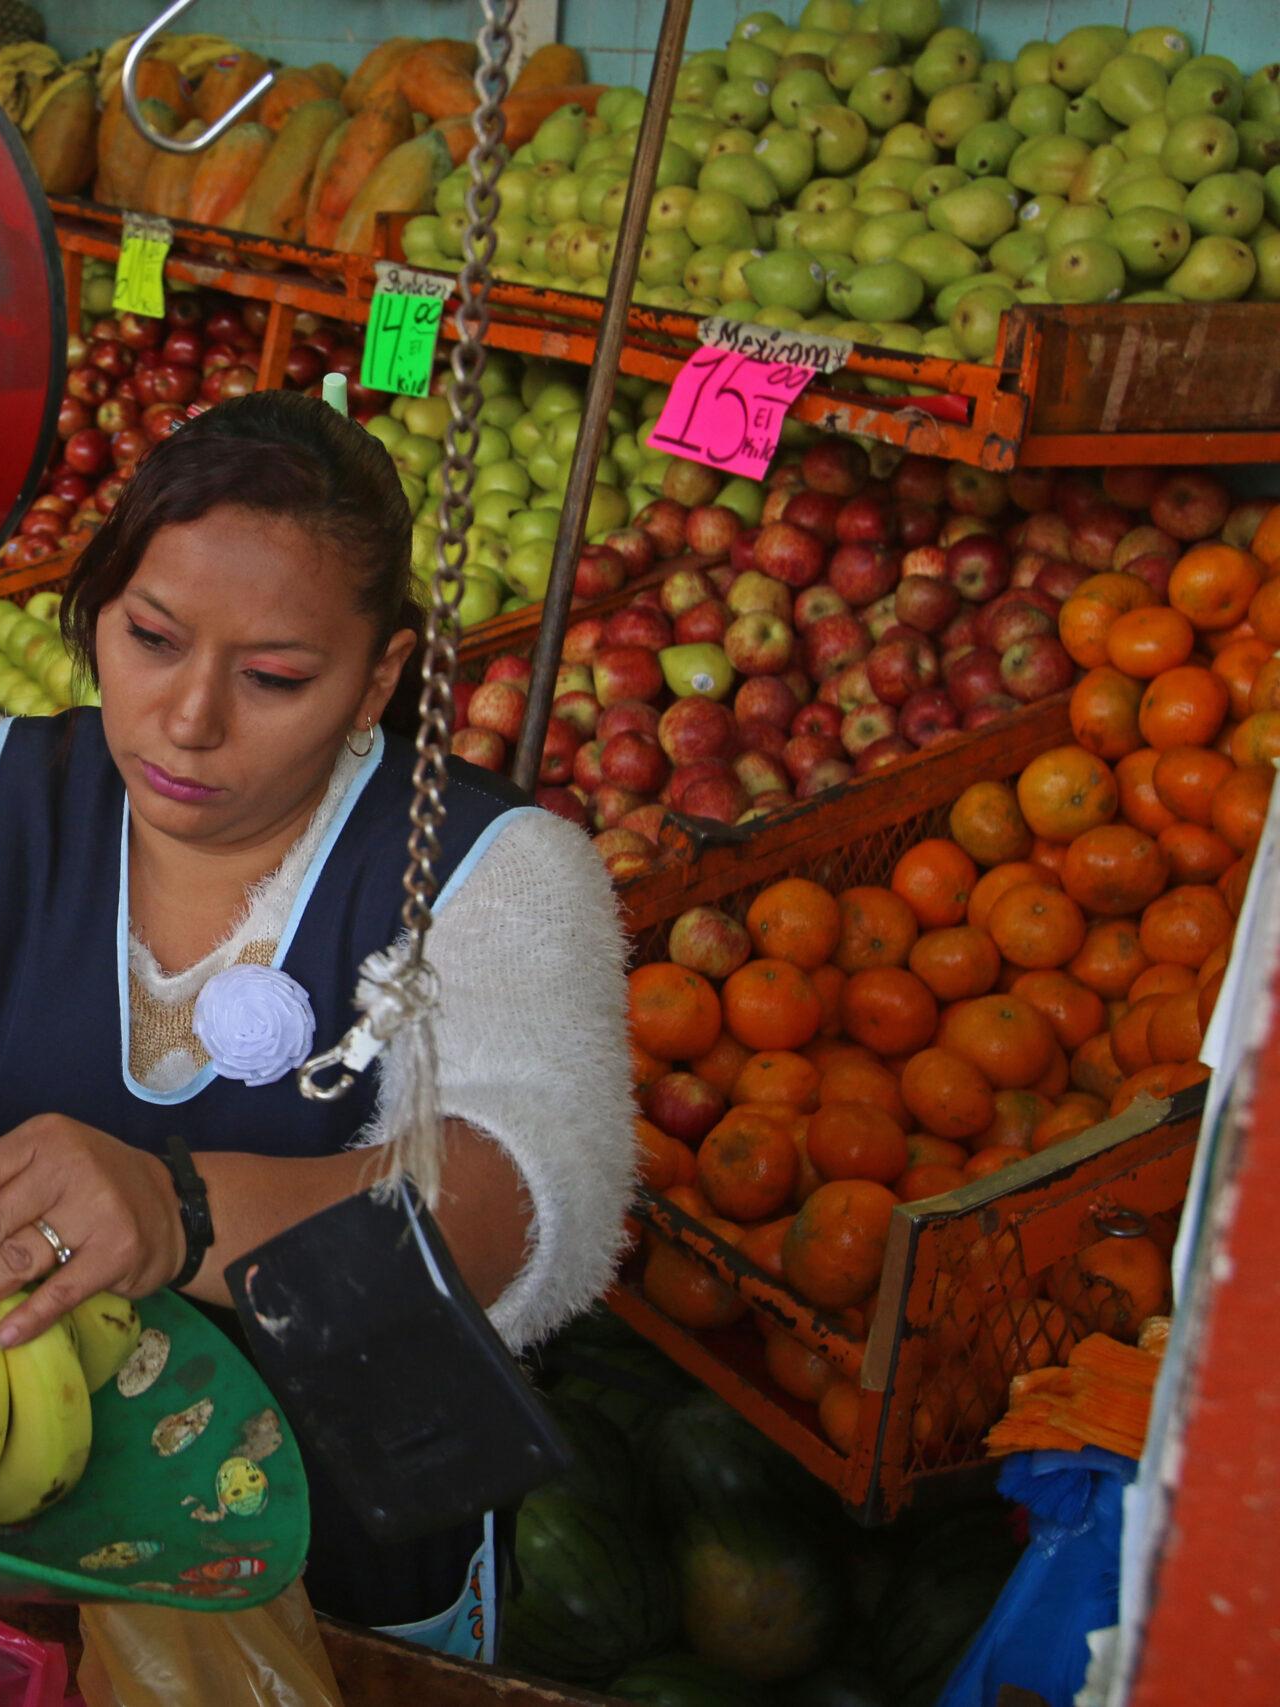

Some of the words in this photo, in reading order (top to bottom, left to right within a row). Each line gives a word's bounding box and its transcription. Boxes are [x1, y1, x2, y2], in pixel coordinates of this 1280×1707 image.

[369, 293, 409, 386] 14
[653, 351, 749, 464] 15
[767, 366, 809, 389] 00
[753, 407, 774, 431] El
